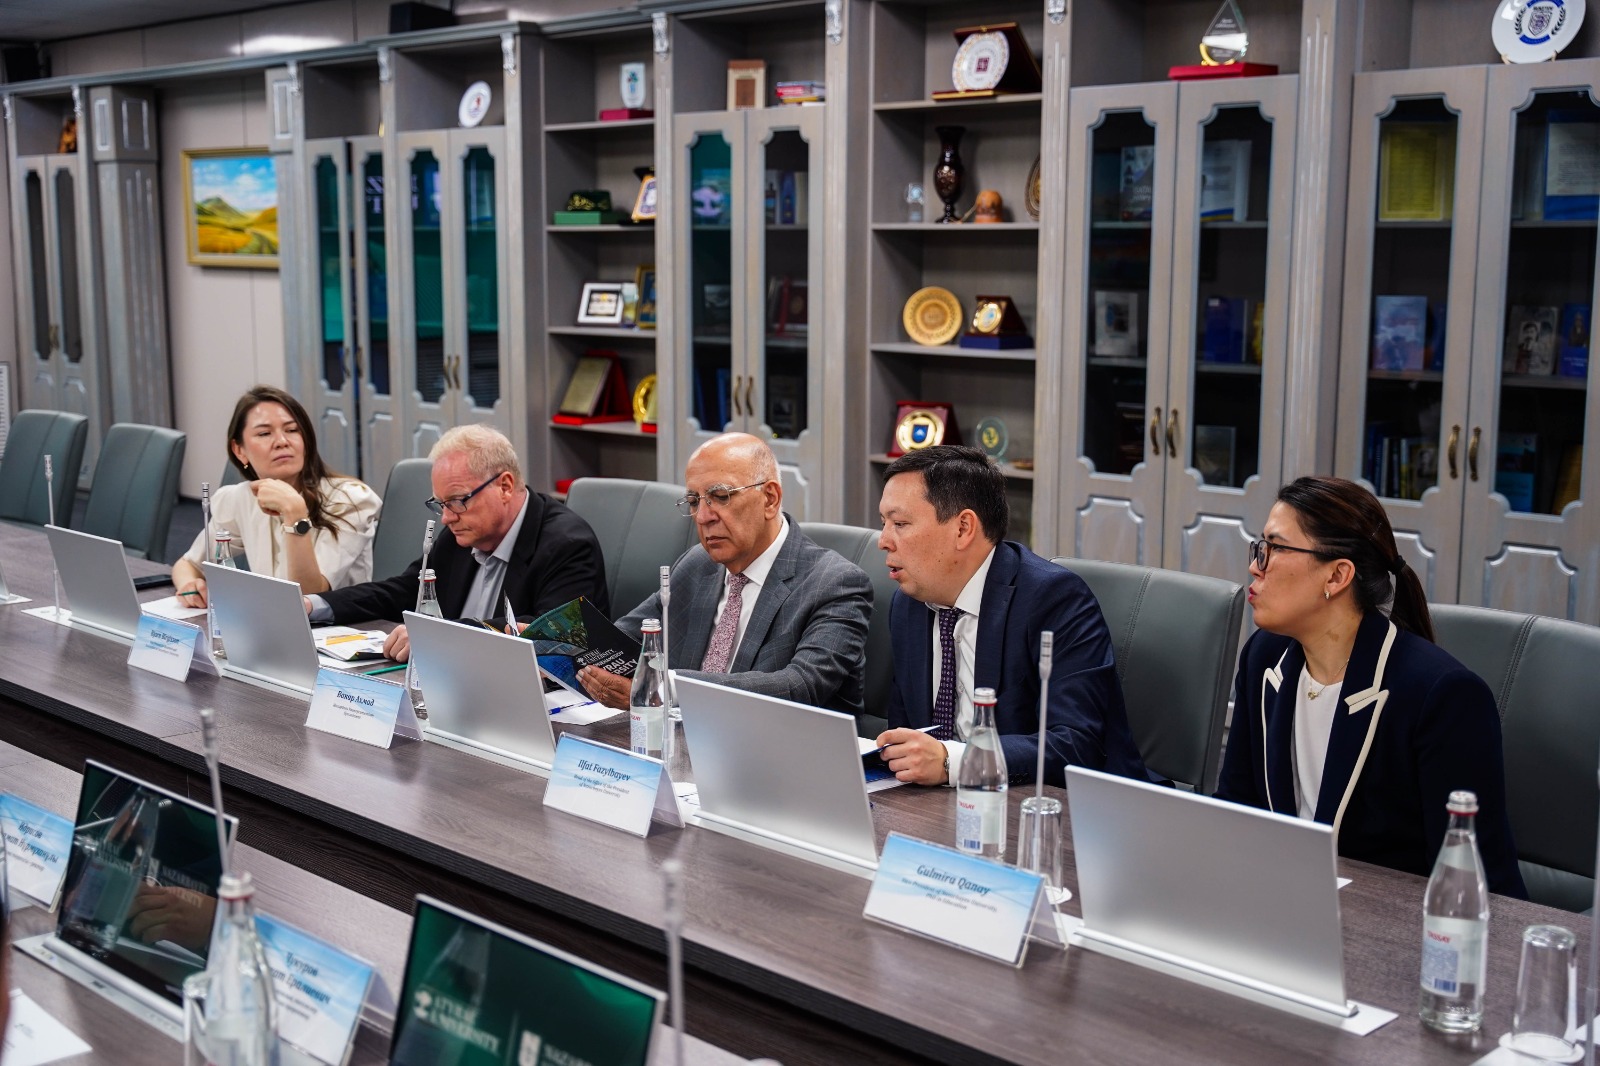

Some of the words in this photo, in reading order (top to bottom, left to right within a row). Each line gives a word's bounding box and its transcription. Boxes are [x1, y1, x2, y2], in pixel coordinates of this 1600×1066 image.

[578, 760, 592, 770] Ilfat
[593, 764, 630, 781] Fazylbayev
[917, 865, 956, 885] Gulmira
[958, 877, 991, 896] Qanay
